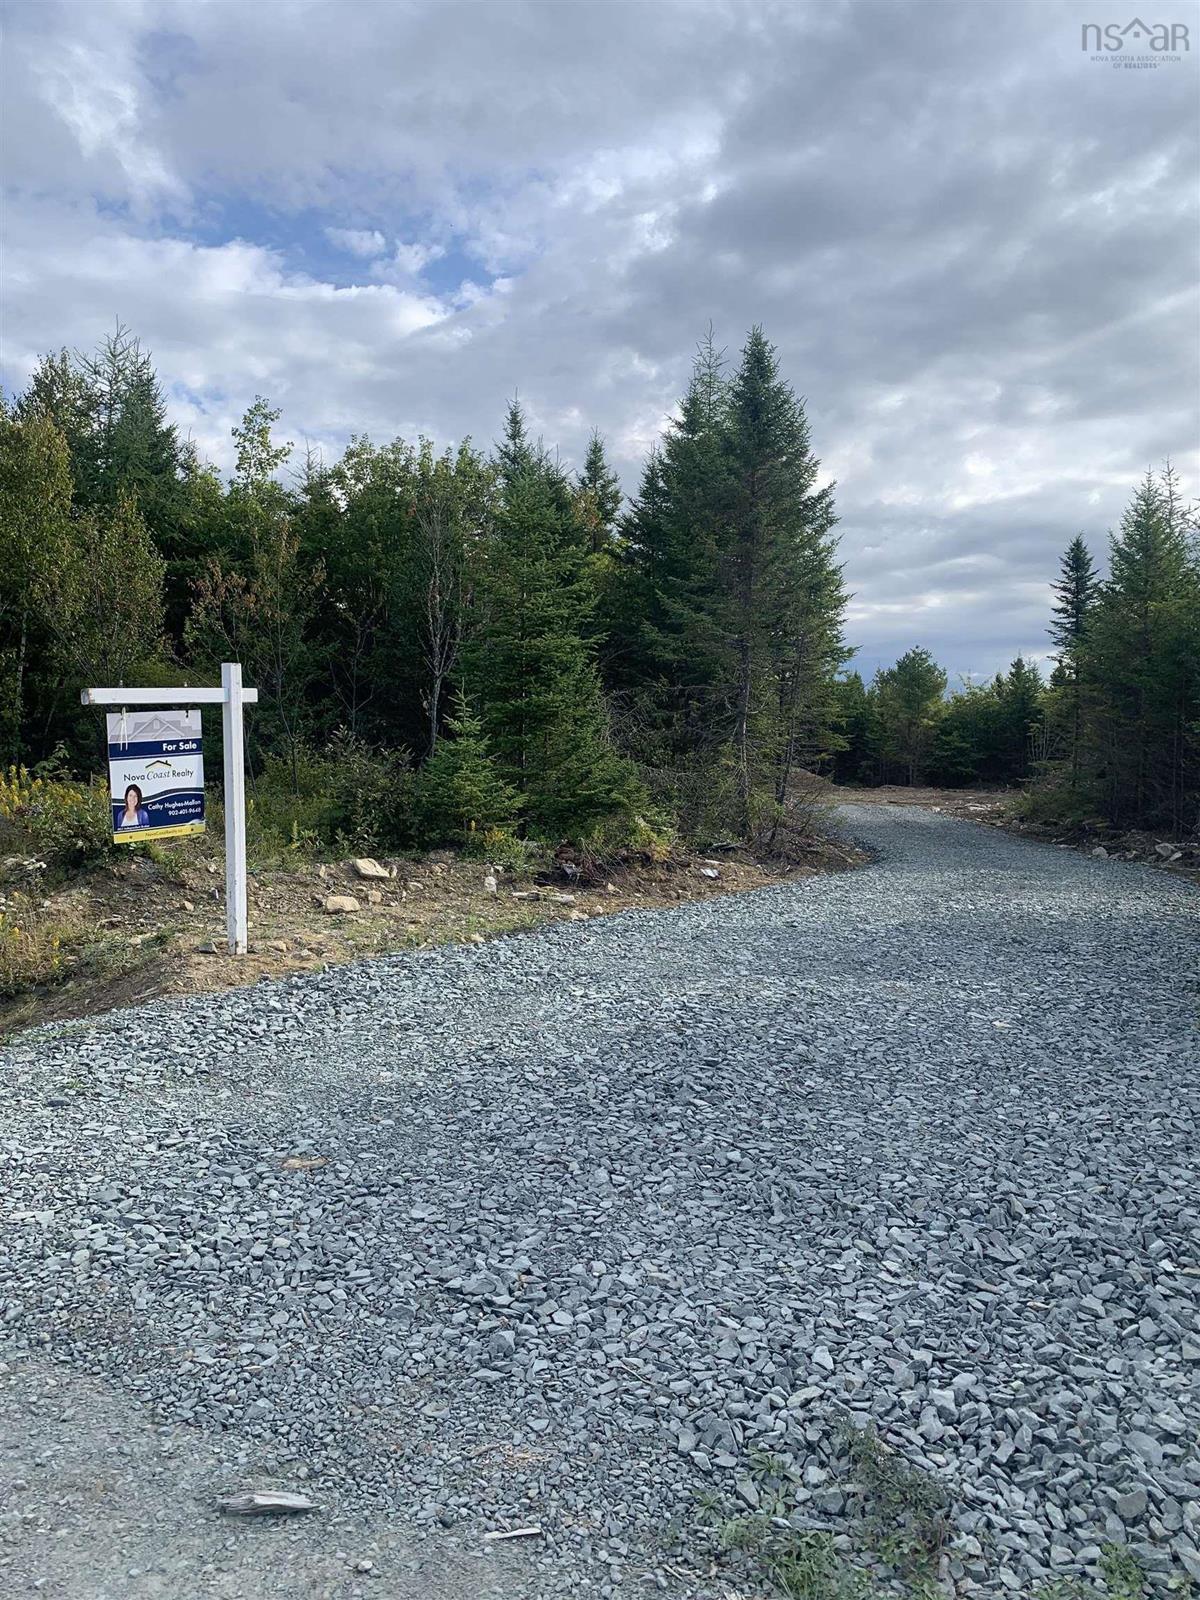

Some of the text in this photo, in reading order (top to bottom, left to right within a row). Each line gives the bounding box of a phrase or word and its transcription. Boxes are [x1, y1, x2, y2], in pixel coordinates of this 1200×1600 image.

[162, 740, 197, 752] For Sale
[123, 768, 194, 782] Nova Coast Realty
[147, 802, 164, 811] Cathy
